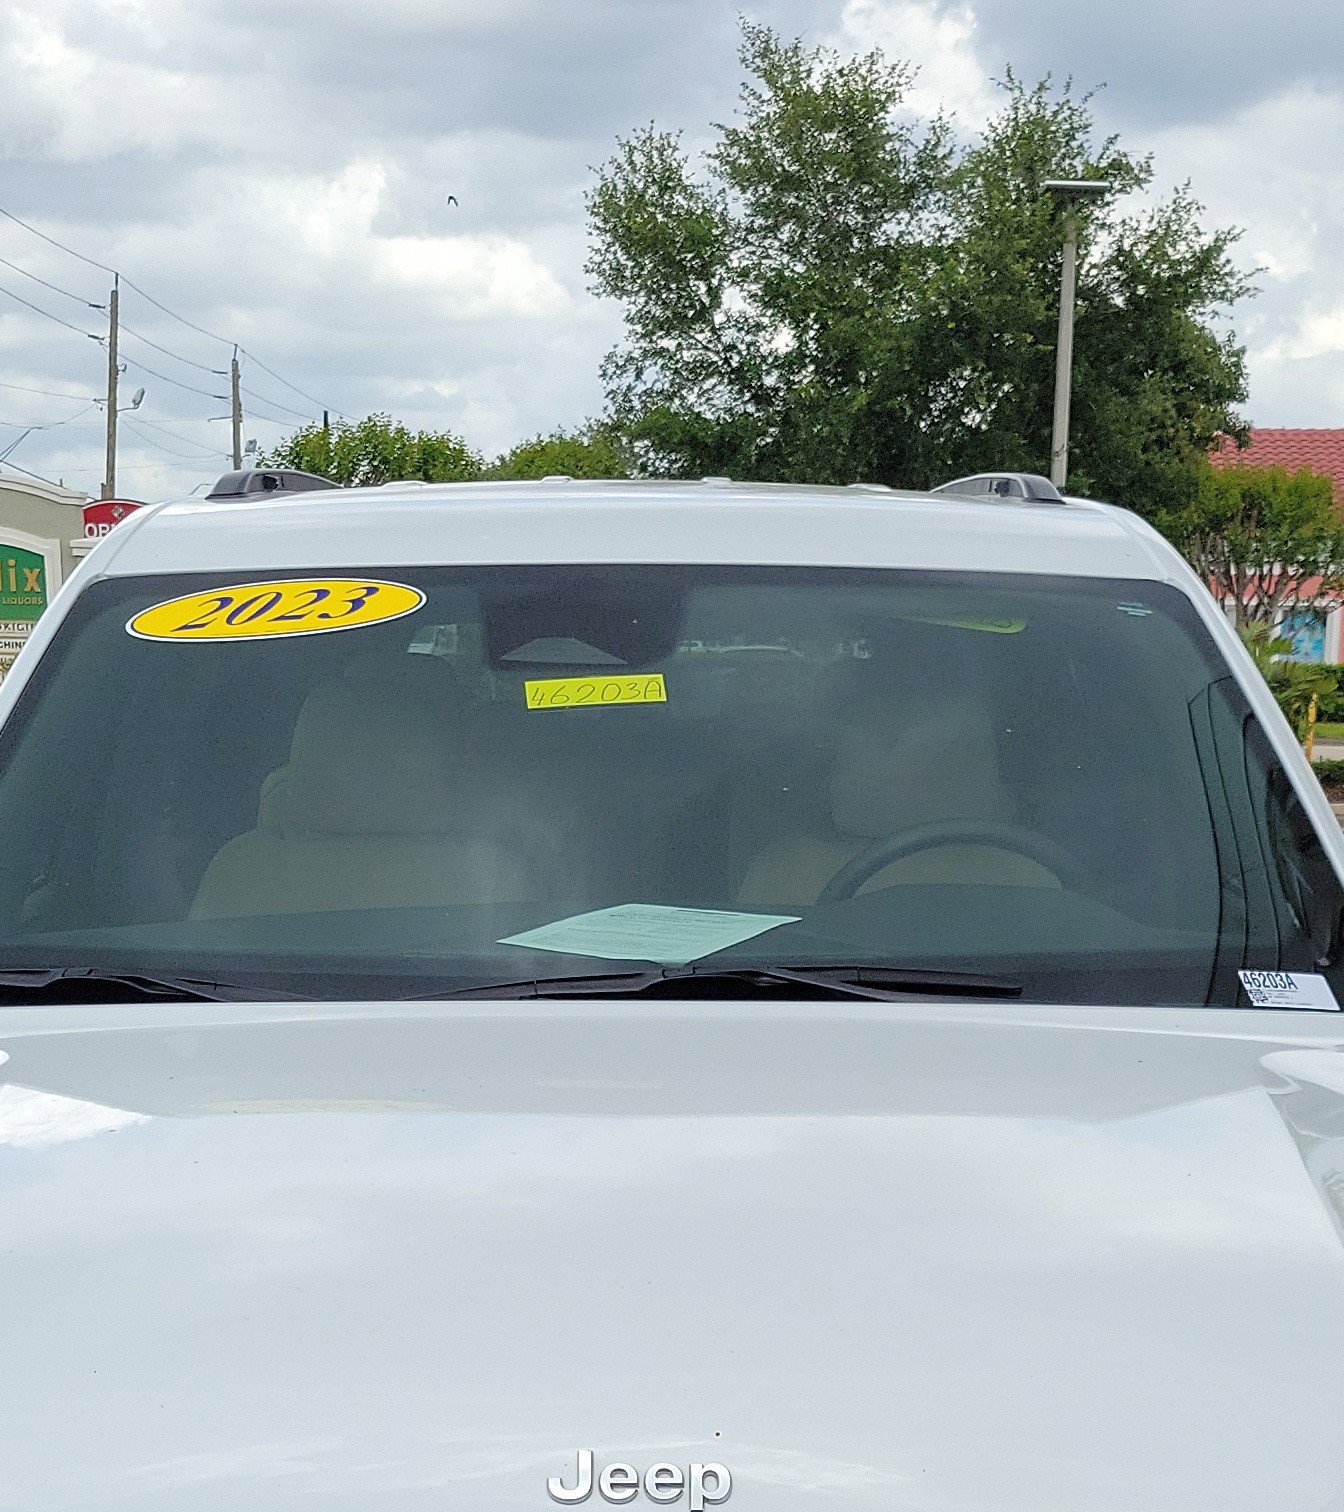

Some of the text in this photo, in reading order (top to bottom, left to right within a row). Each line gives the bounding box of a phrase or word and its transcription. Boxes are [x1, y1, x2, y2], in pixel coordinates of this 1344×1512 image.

[170, 586, 380, 632] 2023
[532, 679, 662, 706] 46203A
[1243, 972, 1298, 990] 46203A
